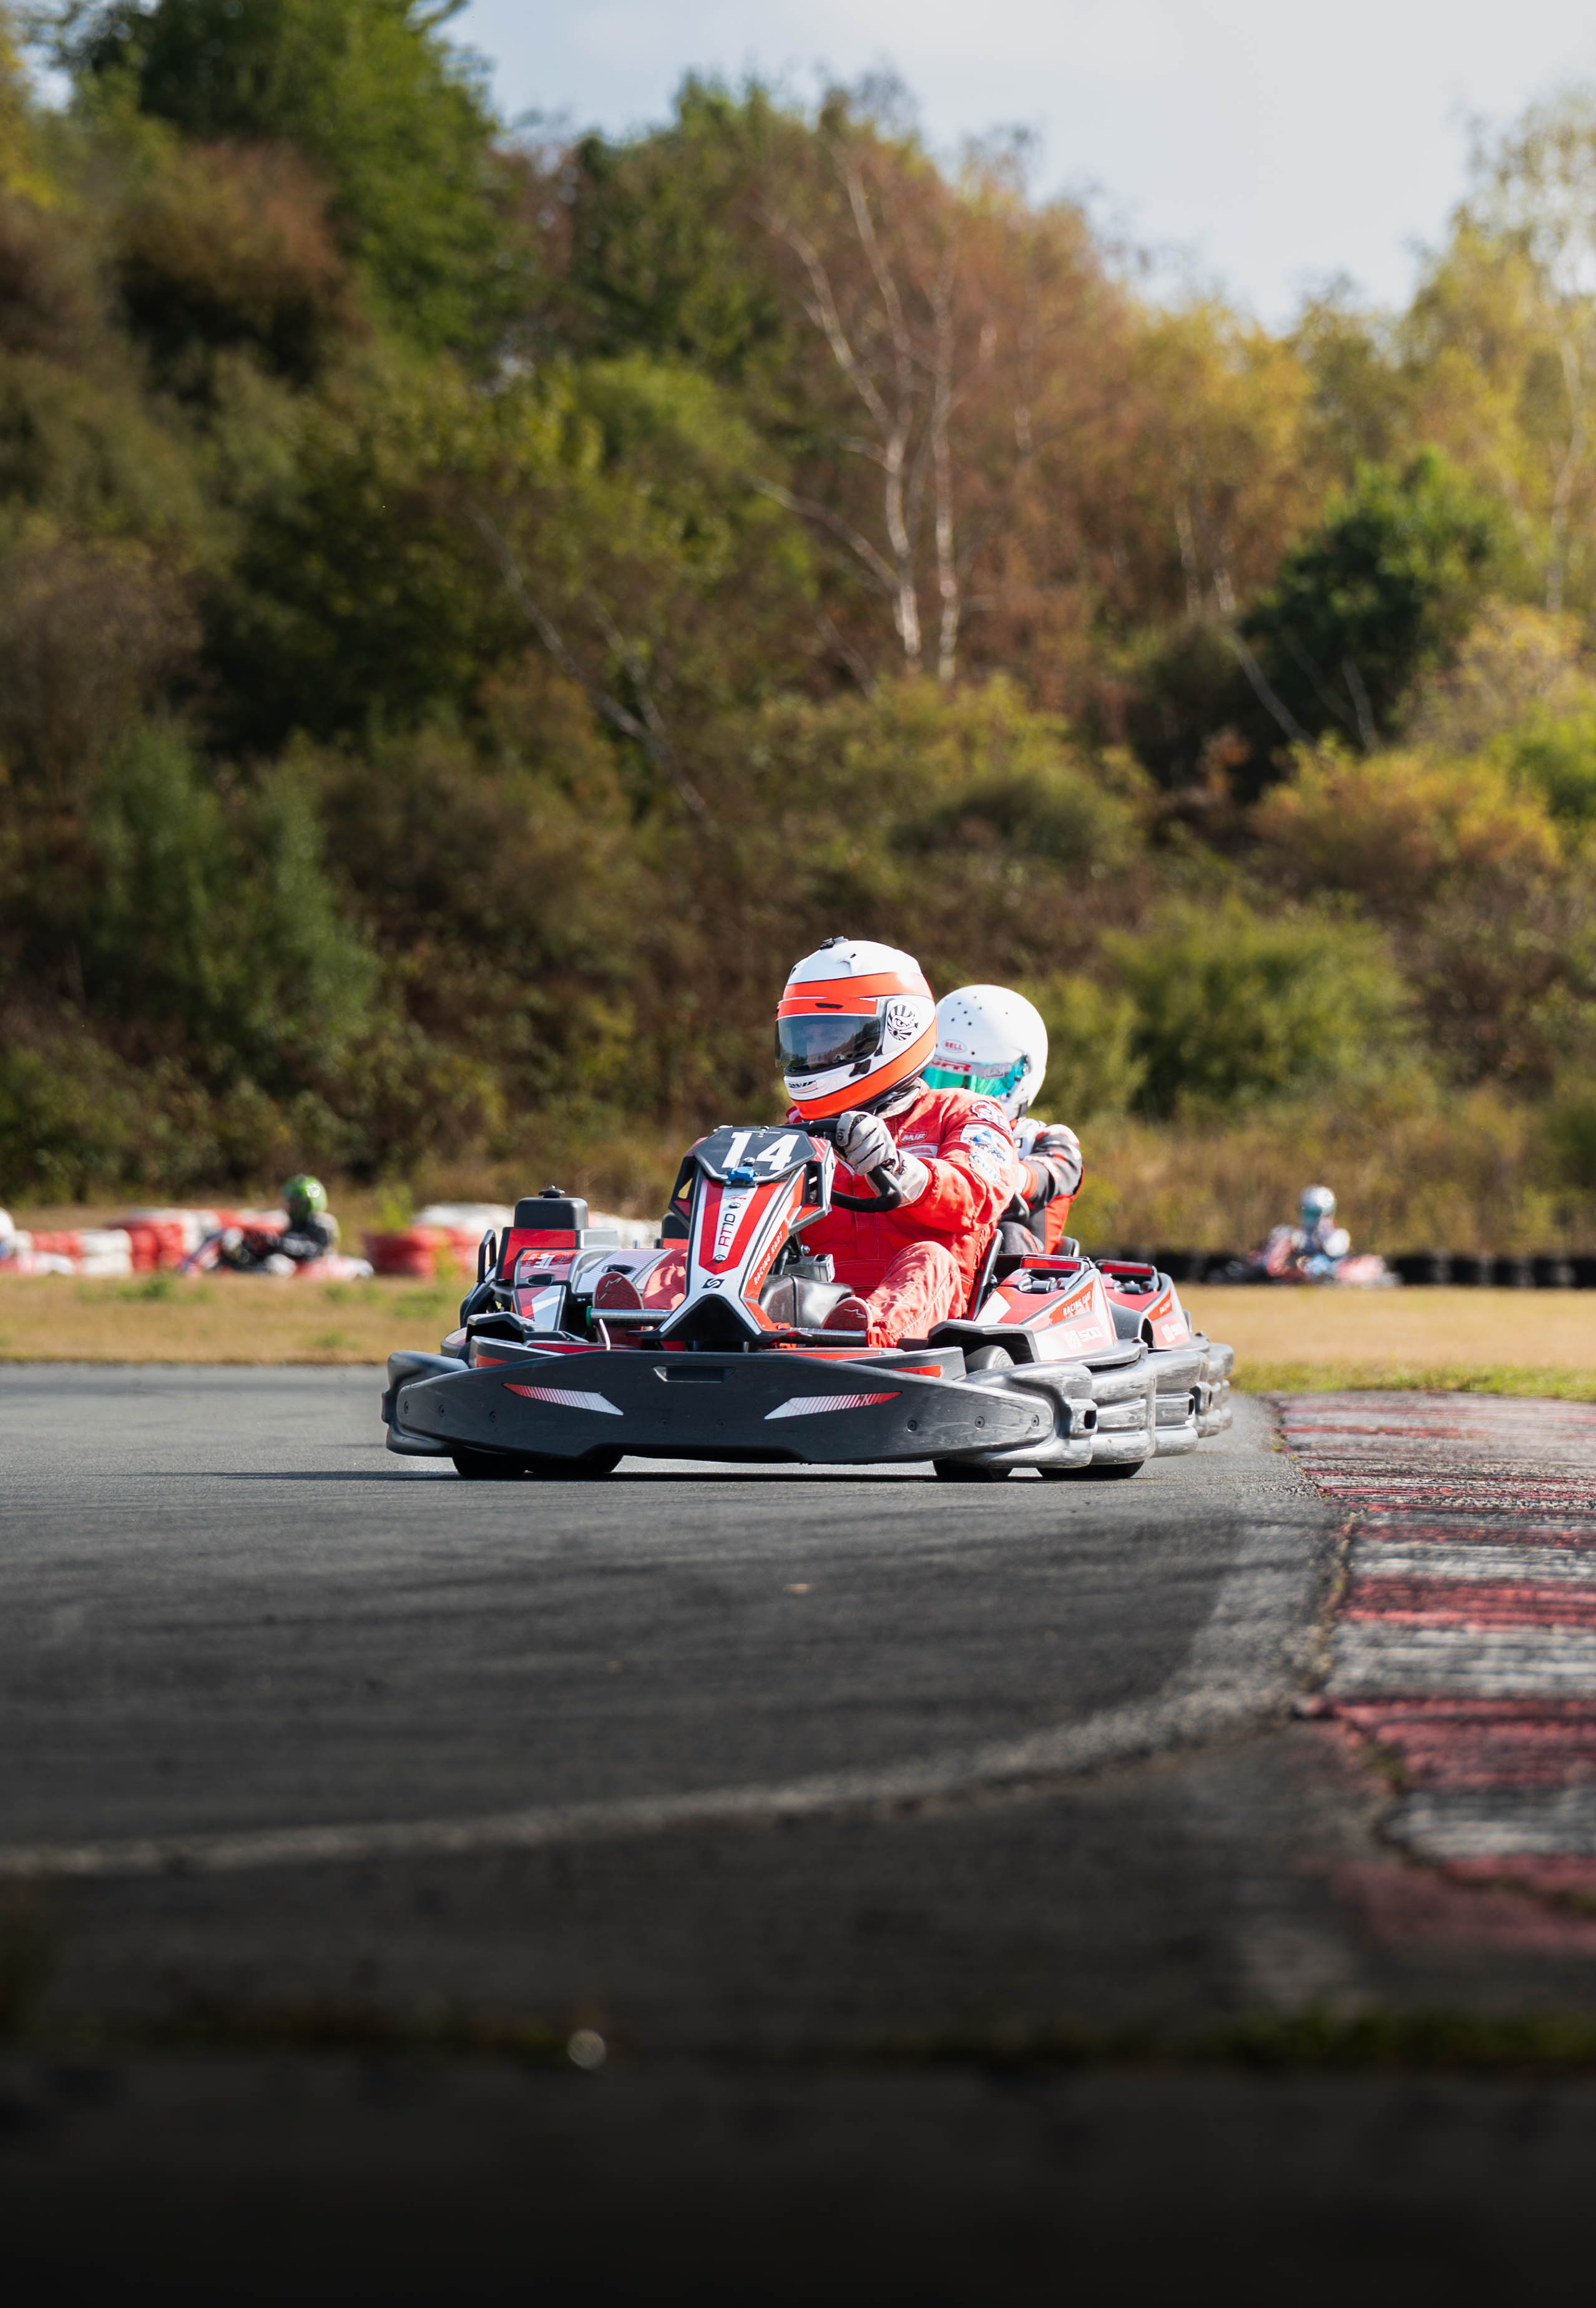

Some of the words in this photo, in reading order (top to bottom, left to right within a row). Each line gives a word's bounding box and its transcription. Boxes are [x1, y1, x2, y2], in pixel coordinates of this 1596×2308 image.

[944, 1041, 962, 1050] BELL
[721, 1132, 800, 1171] 14
[718, 1213, 736, 1247] RT10
[753, 1253, 771, 1286] RACING
[770, 1231, 783, 1254] KART
